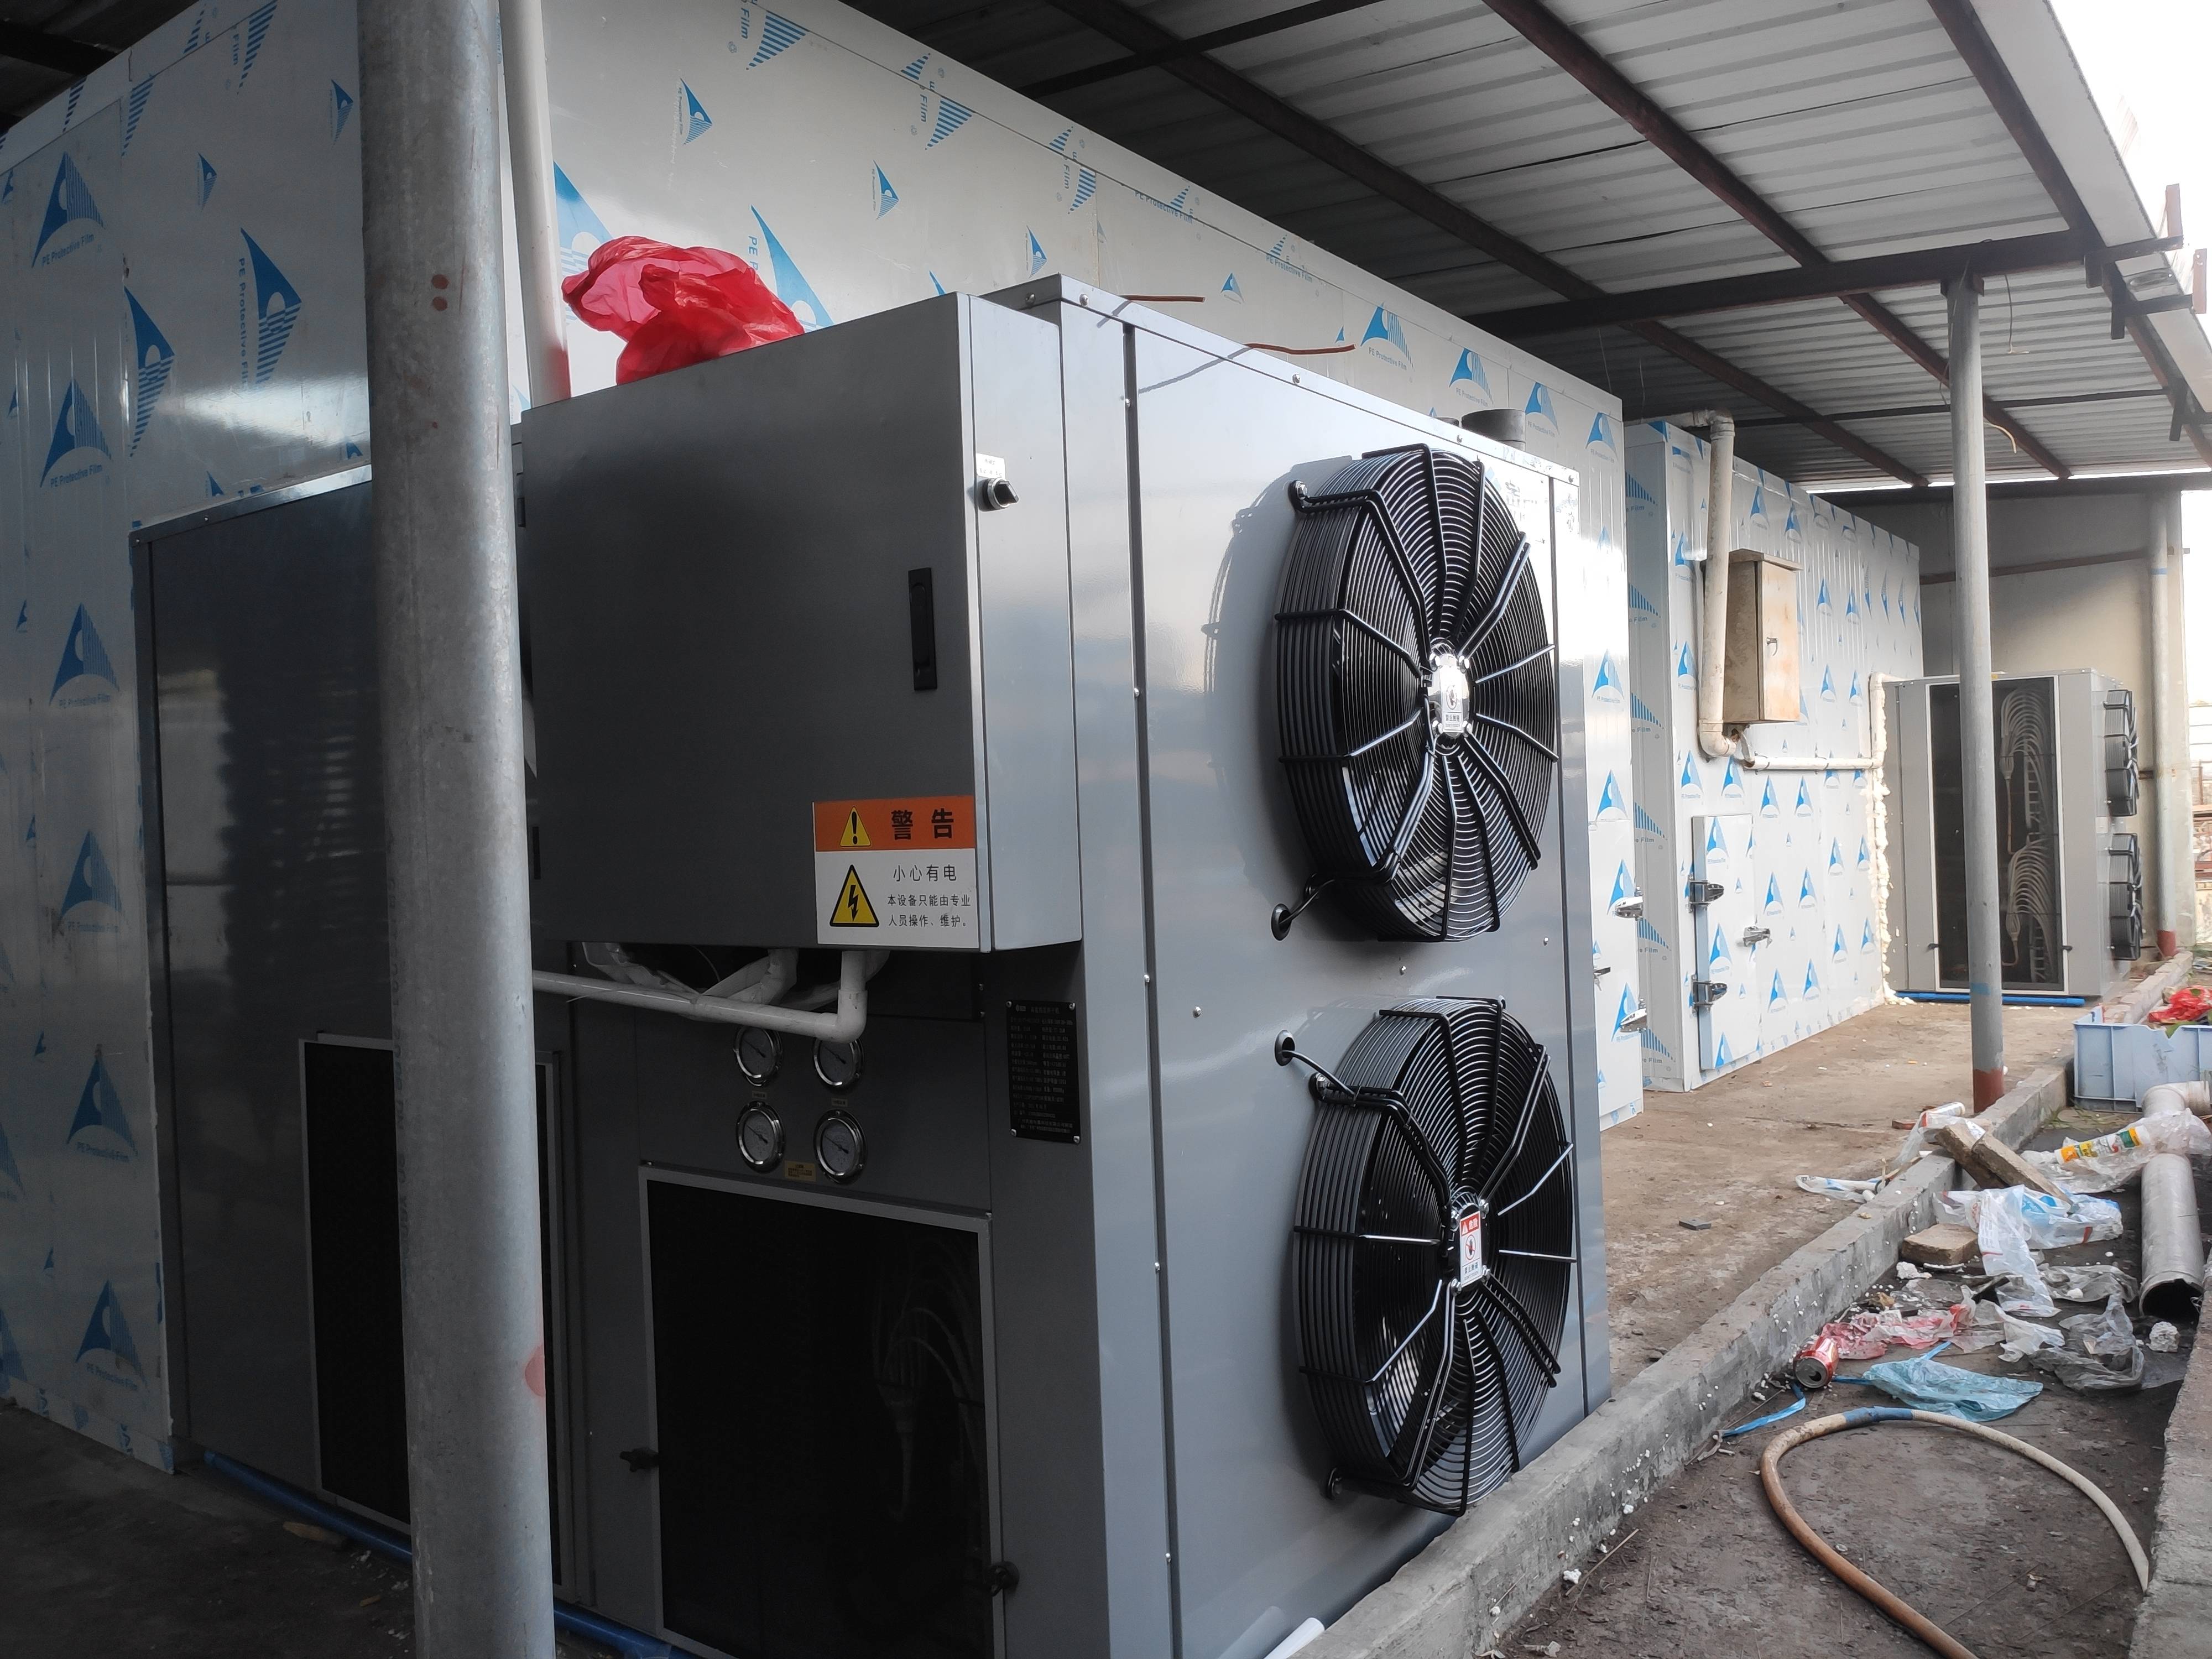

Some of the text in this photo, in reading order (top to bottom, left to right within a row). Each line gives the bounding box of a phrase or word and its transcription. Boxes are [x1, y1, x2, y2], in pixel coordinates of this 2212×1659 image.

[741, 8, 750, 39] Film
[748, 235, 758, 255] PE
[239, 258, 245, 278] PE
[891, 808, 954, 841] 警告
[893, 864, 957, 881] 小心有电
[887, 894, 971, 907] 本设备只能由专业
[888, 914, 967, 927] 人员操作、维护。
